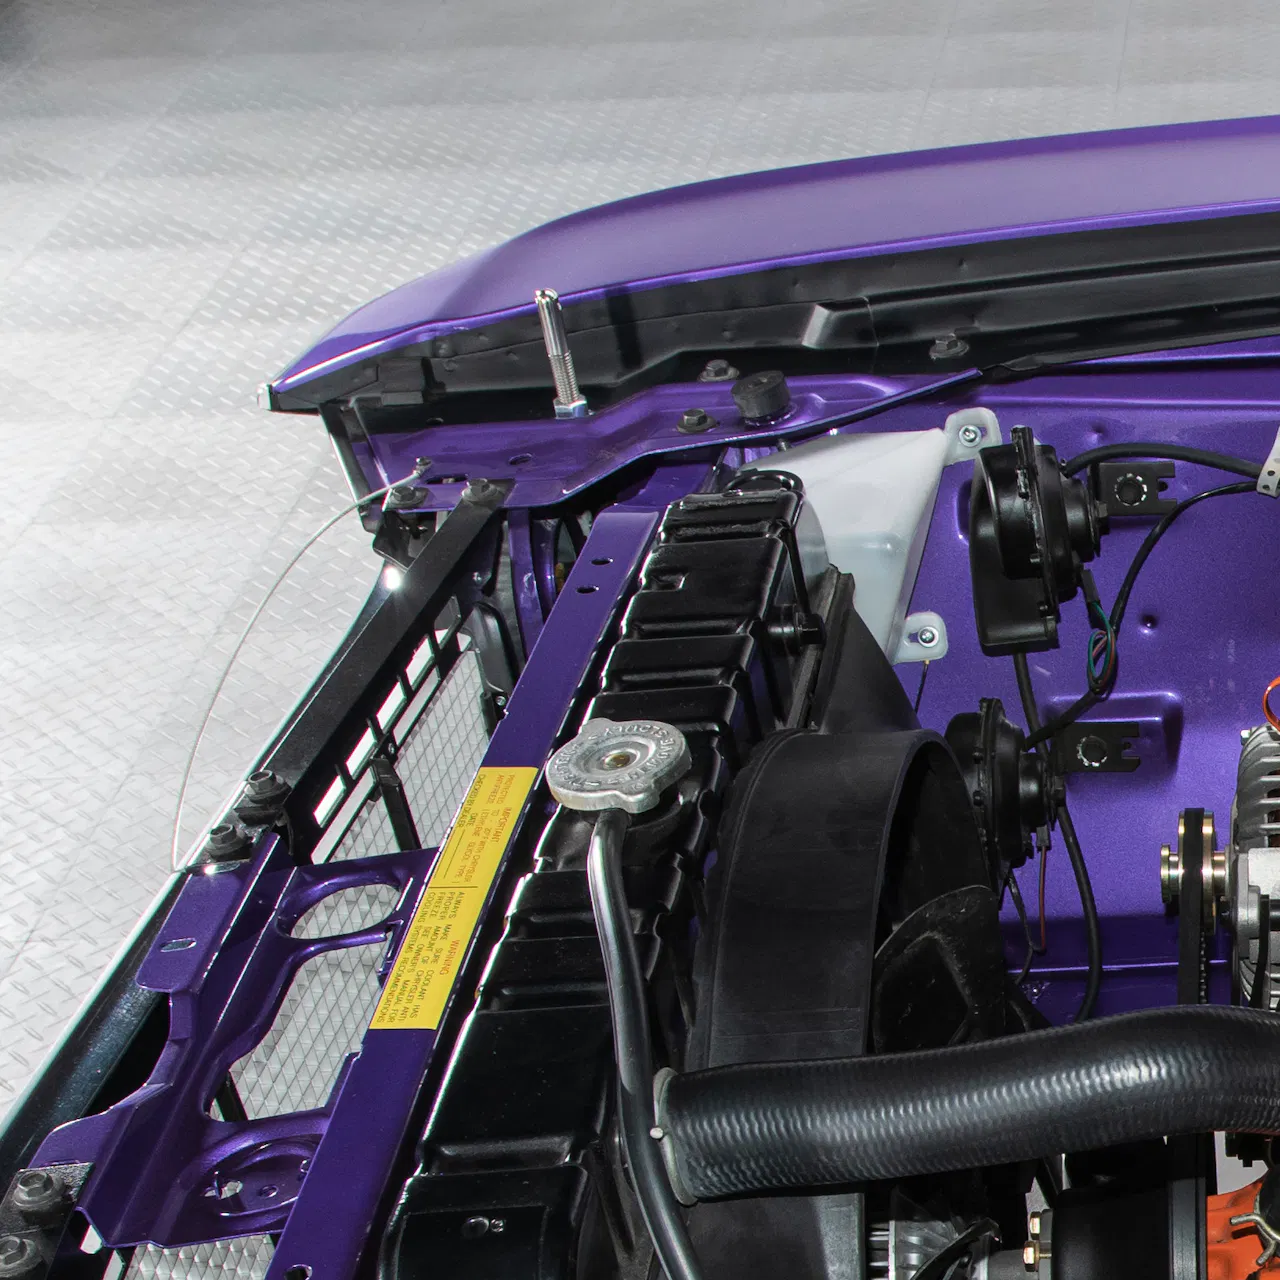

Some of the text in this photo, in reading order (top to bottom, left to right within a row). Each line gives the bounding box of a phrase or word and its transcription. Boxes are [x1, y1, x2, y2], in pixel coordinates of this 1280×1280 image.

[468, 774, 486, 798] CHECKED
[455, 807, 472, 827] DEALER
[465, 812, 478, 826] DATE
[489, 807, 512, 842] IMPORTANT
[437, 891, 456, 920] PROPER
[424, 925, 442, 952] AMOUNT
[375, 891, 436, 1022] COOLING SYSTEMS RECOMMENDATIONS
[405, 943, 425, 973] OWNER'S
[408, 891, 465, 1019] ALWAYS MAKE SURE COOLANT HAS
[419, 956, 430, 964] OF
[437, 939, 461, 975] WARNING
[393, 979, 411, 1006] MANUAL
[403, 969, 425, 1003] CHRYSLER
[386, 1008, 399, 1022] FOR
